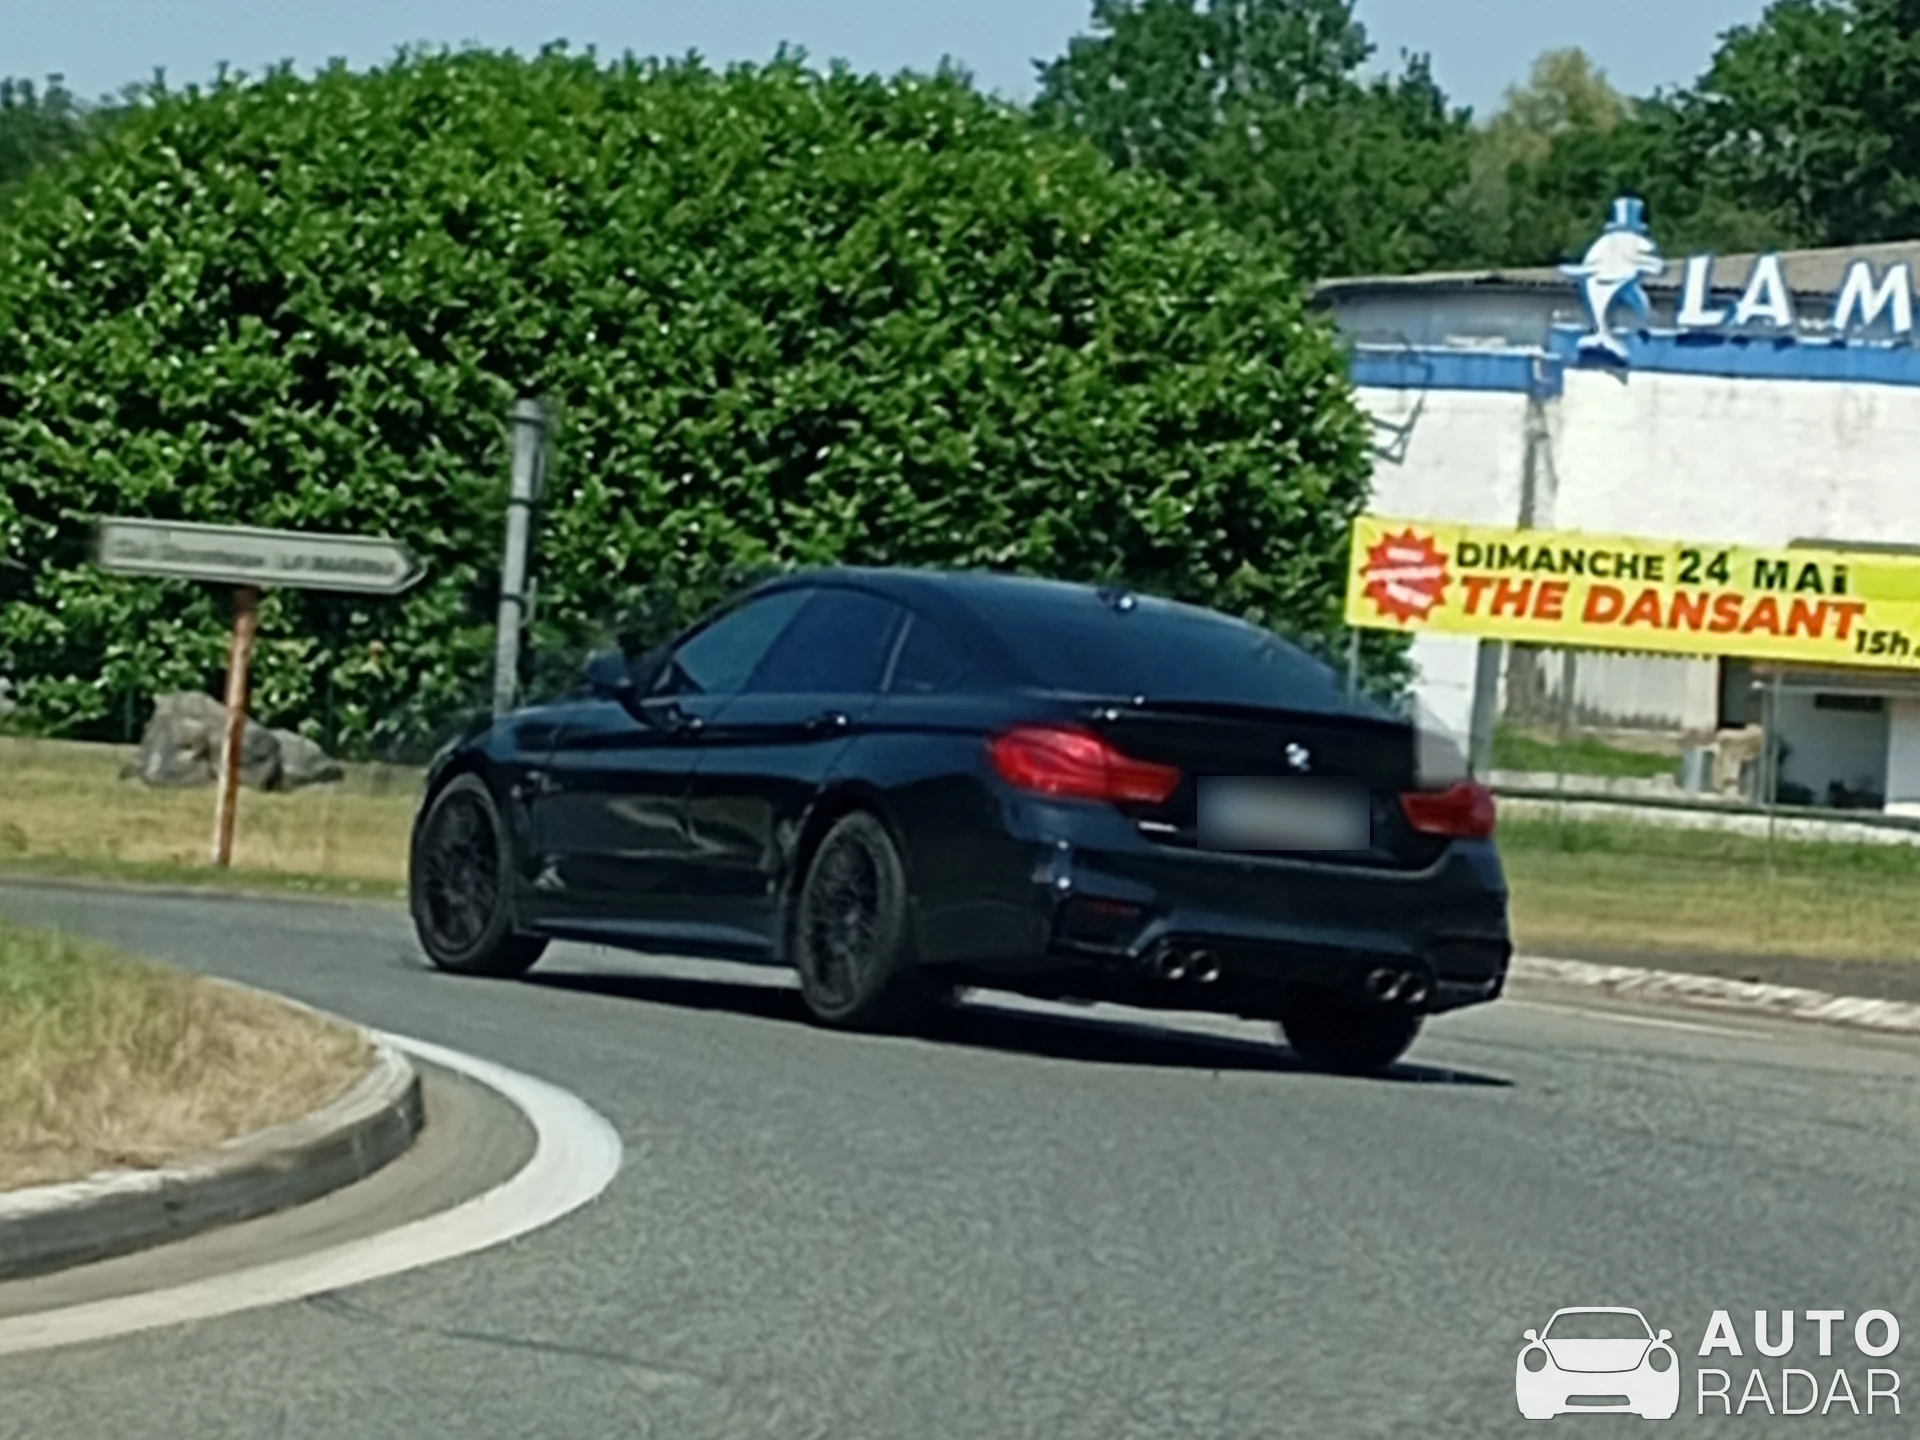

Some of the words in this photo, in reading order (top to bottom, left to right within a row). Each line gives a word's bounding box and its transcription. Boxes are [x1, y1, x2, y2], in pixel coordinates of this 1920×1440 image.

[1676, 253, 1793, 328] LA
[1455, 541, 1665, 583] DIMANCHE
[1677, 548, 1731, 585] 24
[1460, 575, 1569, 621] THE
[1580, 584, 1866, 641] DANSANT
